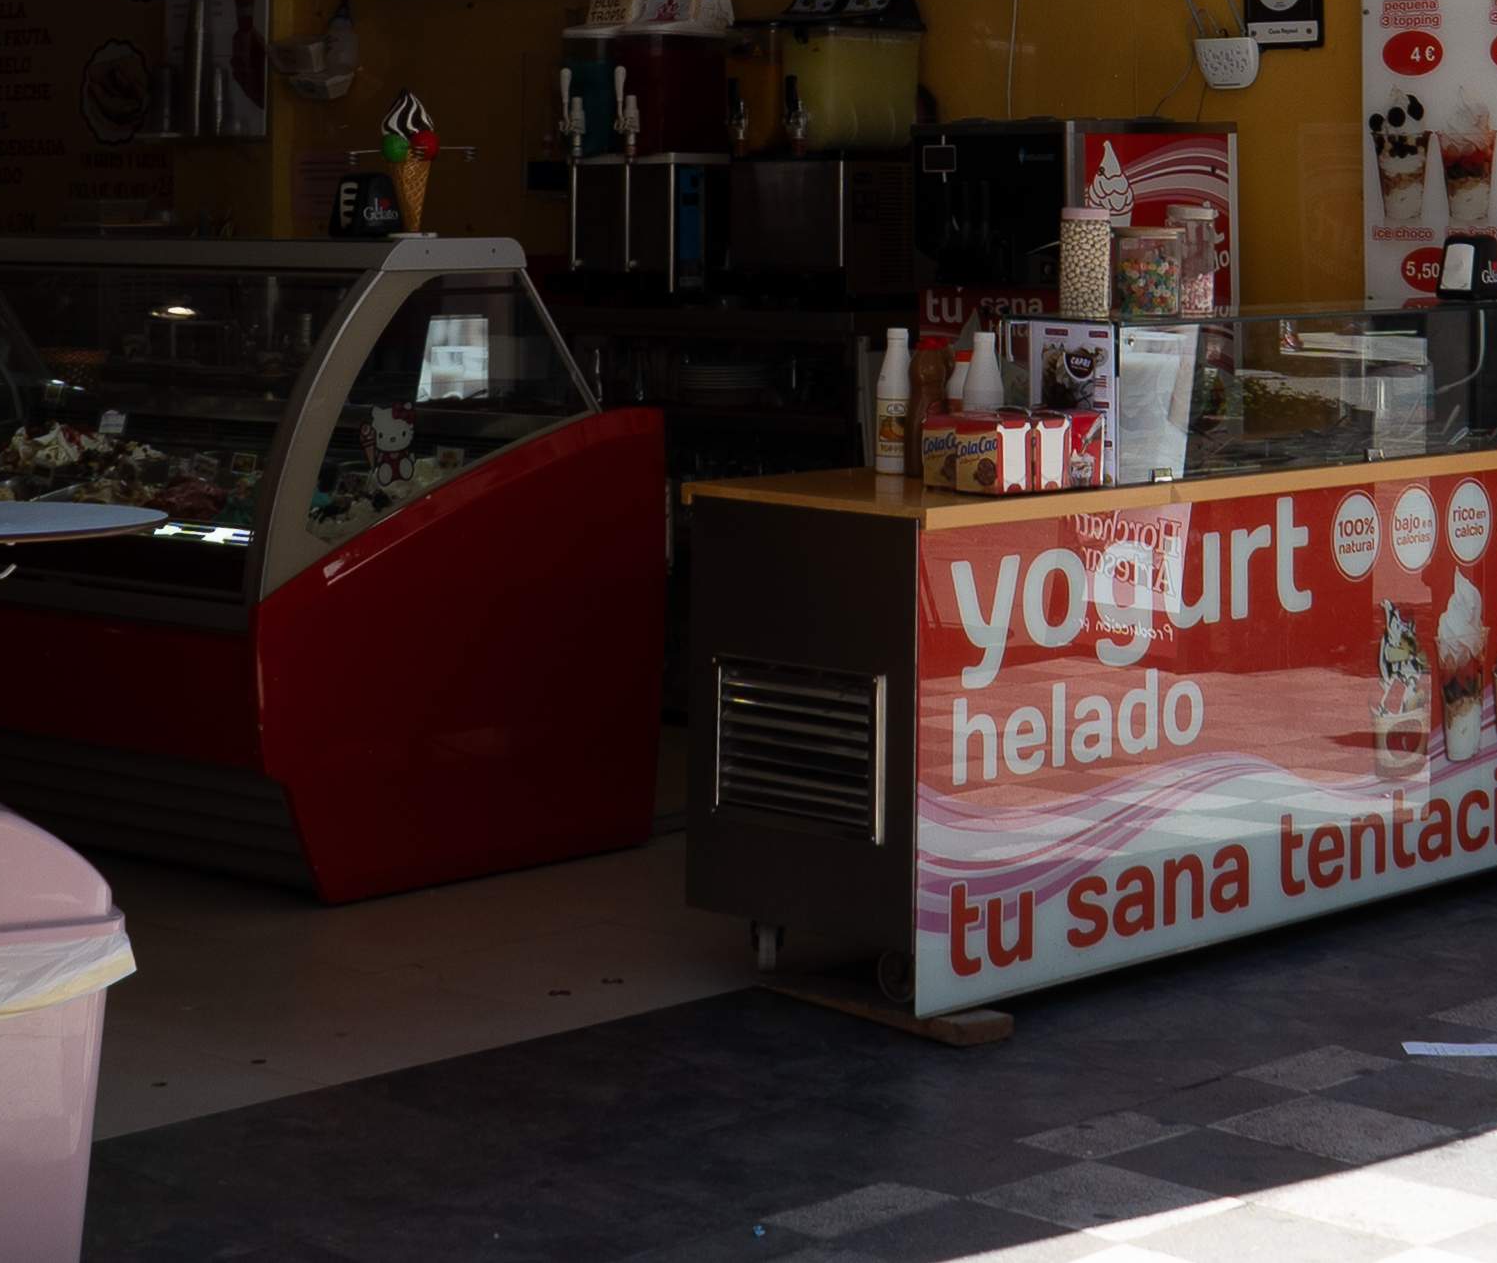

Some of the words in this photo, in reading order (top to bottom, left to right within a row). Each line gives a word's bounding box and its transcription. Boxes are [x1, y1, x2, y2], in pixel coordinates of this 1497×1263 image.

[1382, 15, 1391, 27] 3
[1393, 14, 1440, 30] topping
[1396, 226, 1433, 239] choco
[980, 295, 1044, 315] sana
[1394, 513, 1420, 532] bajo
[1453, 505, 1475, 523] rico
[1476, 510, 1486, 519] en
[1338, 517, 1375, 539] 100%
[1454, 522, 1484, 539] calcio
[1338, 538, 1375, 555] natural
[949, 495, 1313, 689] yogurt
[951, 668, 1205, 786] helado
[946, 882, 1037, 979] tu
[1063, 841, 1252, 951] sana
